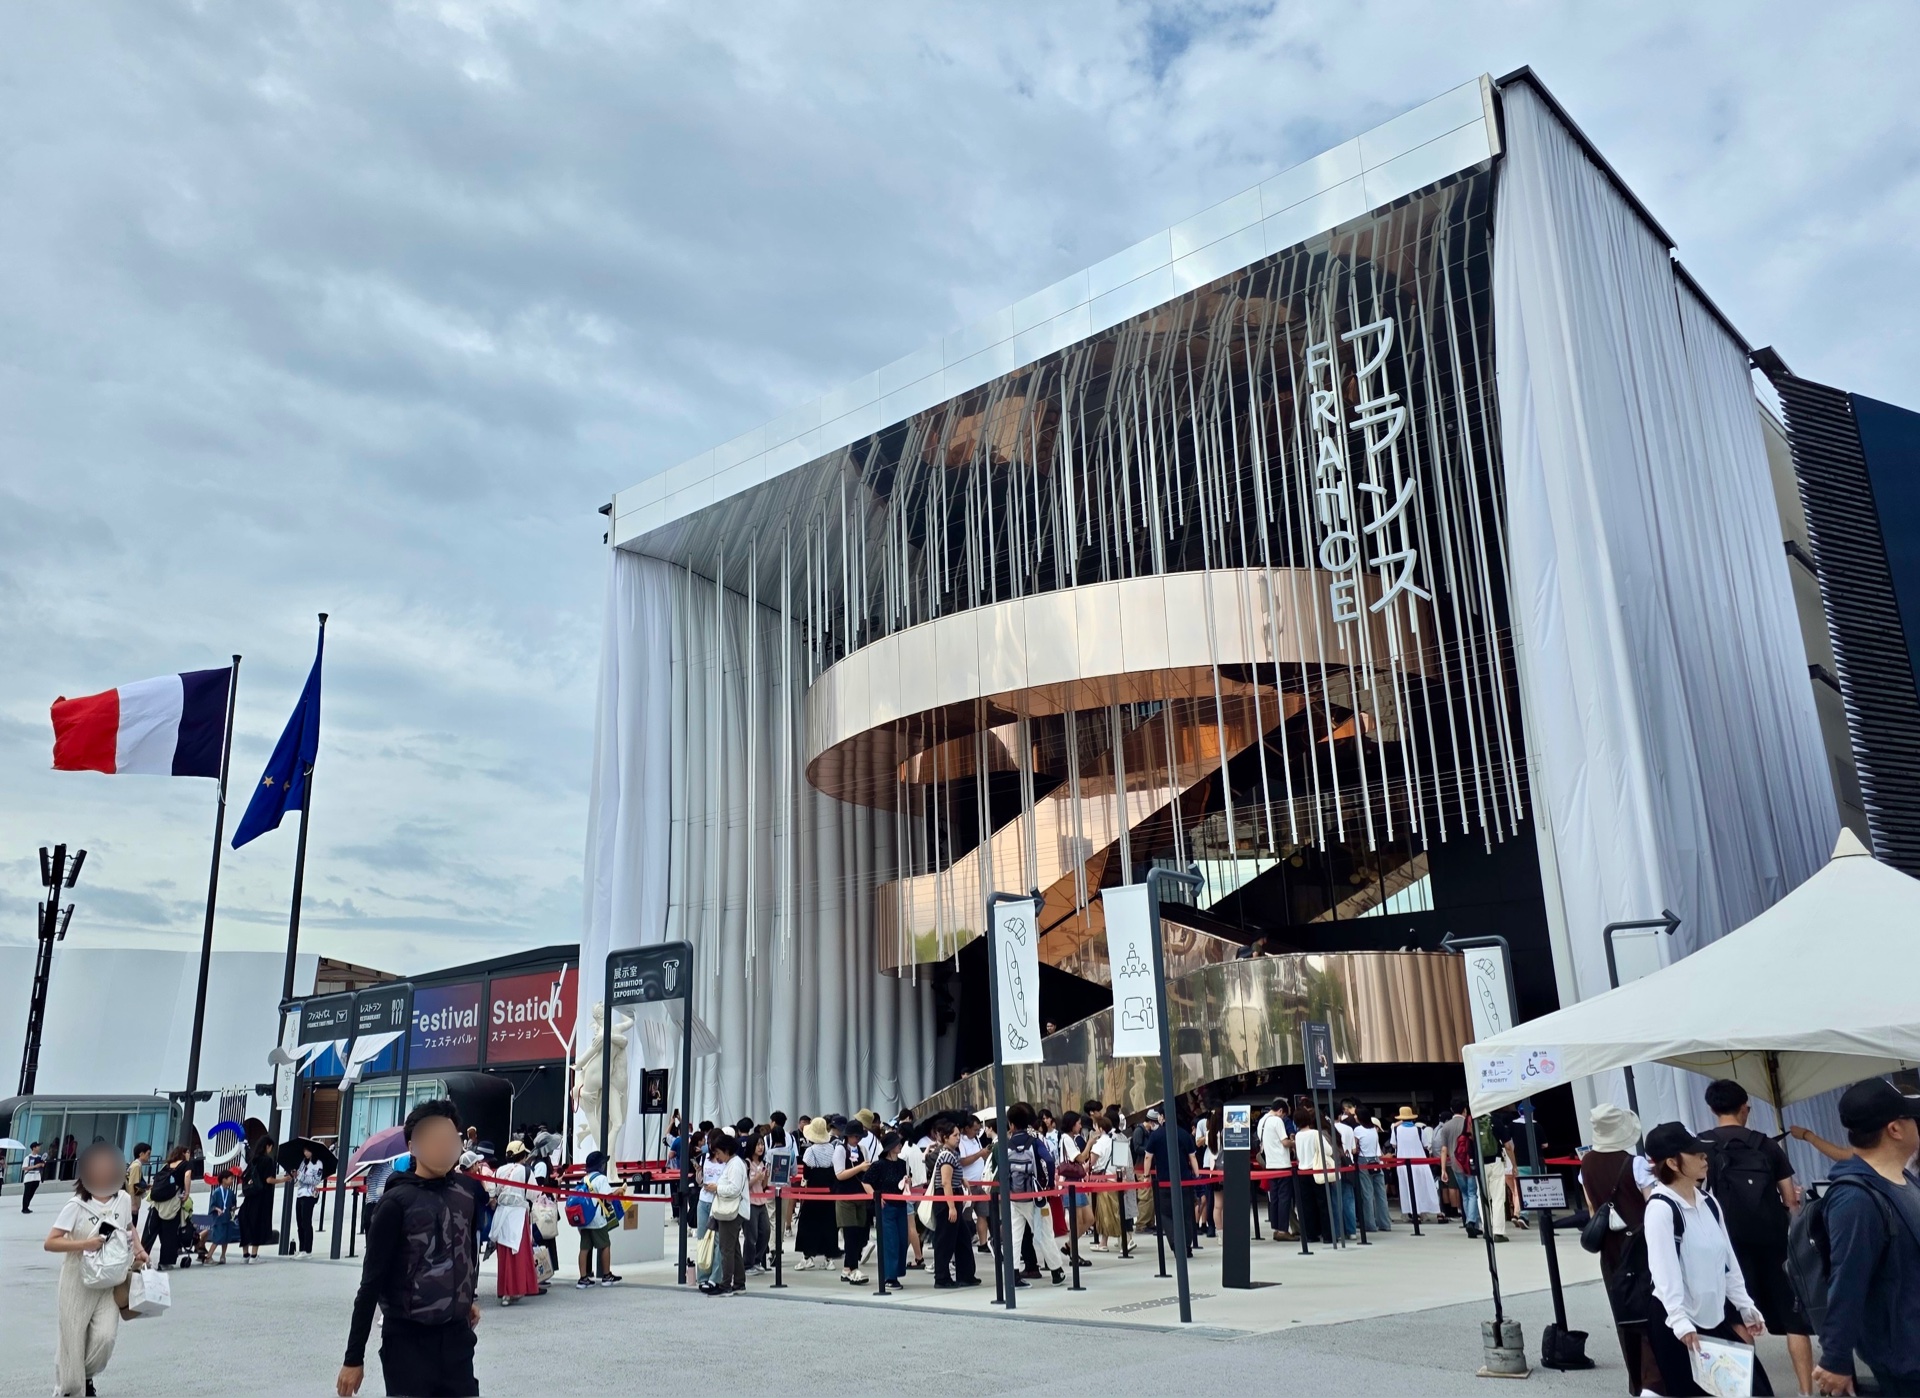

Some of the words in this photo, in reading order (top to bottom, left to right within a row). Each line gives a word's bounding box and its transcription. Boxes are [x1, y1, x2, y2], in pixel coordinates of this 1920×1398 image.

[1341, 317, 1432, 613] フランス
[1306, 341, 1360, 624] FRANCE
[614, 966, 637, 979] 展示室
[614, 979, 643, 988] EXHIBITION
[614, 989, 644, 998] EXPOSITION
[360, 1003, 381, 1013] レストラン
[492, 996, 562, 1025] Station
[309, 1010, 330, 1020] ファストパス
[491, 1028, 541, 1042] ステーション
[1482, 1069, 1512, 1077] 優先レーン
